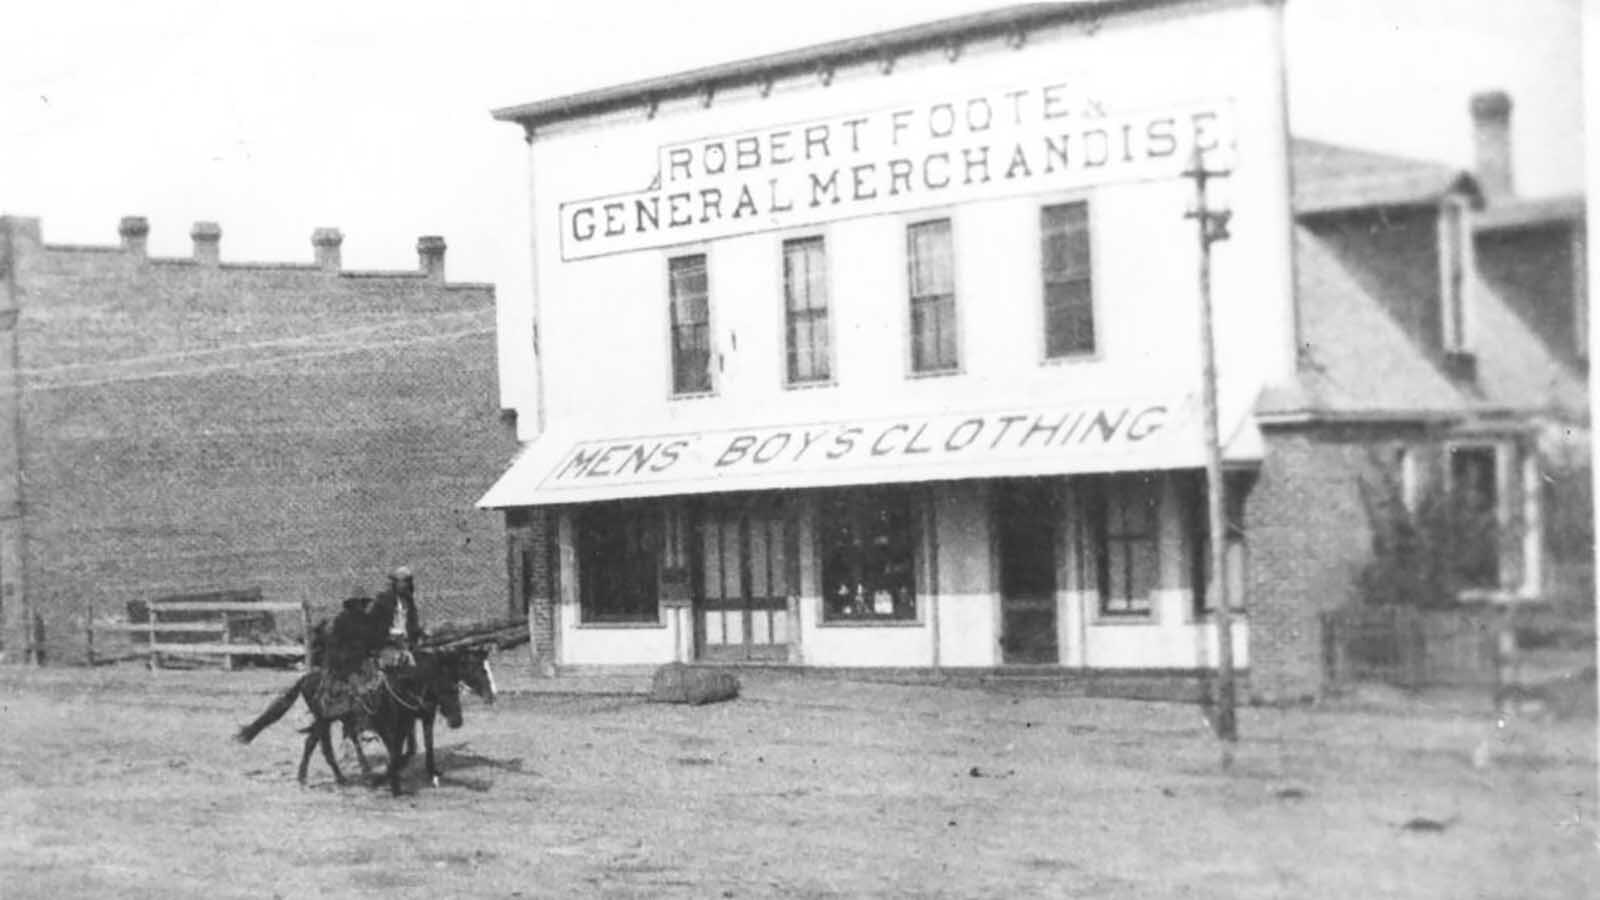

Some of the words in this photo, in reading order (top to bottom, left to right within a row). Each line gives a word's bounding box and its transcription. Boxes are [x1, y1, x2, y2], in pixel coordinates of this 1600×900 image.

[669, 118, 869, 181] ROBERT
[891, 83, 1070, 145] FOOTE
[571, 178, 794, 242] GENERAL
[713, 427, 864, 467] BOYS
[870, 406, 1168, 456] CLOTHING
